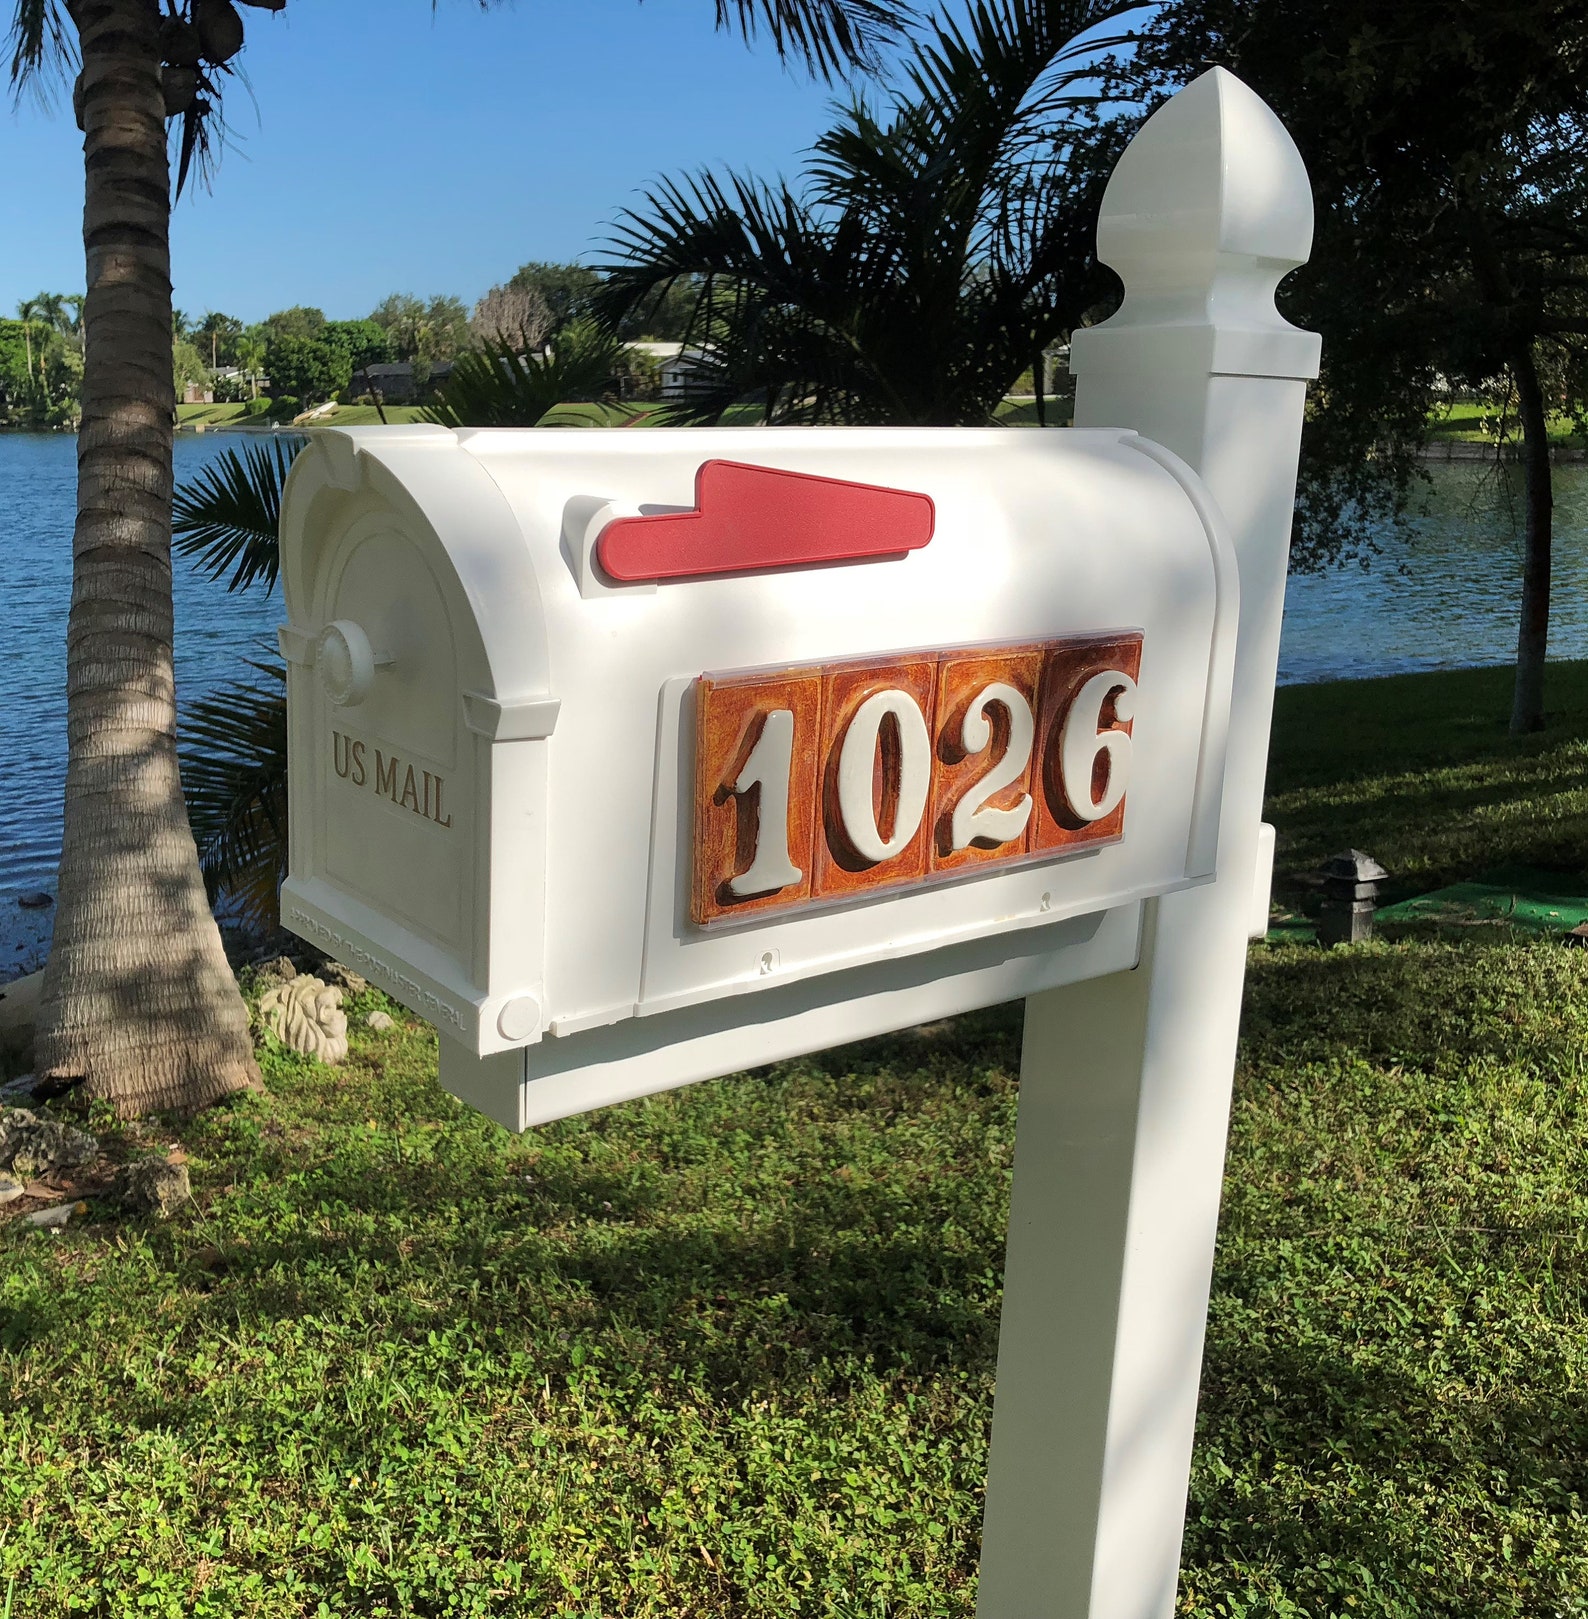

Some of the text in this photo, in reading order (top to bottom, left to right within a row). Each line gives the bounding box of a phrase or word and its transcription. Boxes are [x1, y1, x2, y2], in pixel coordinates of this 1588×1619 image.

[332, 730, 451, 828] US MAIL
[729, 670, 1138, 896] 1026
